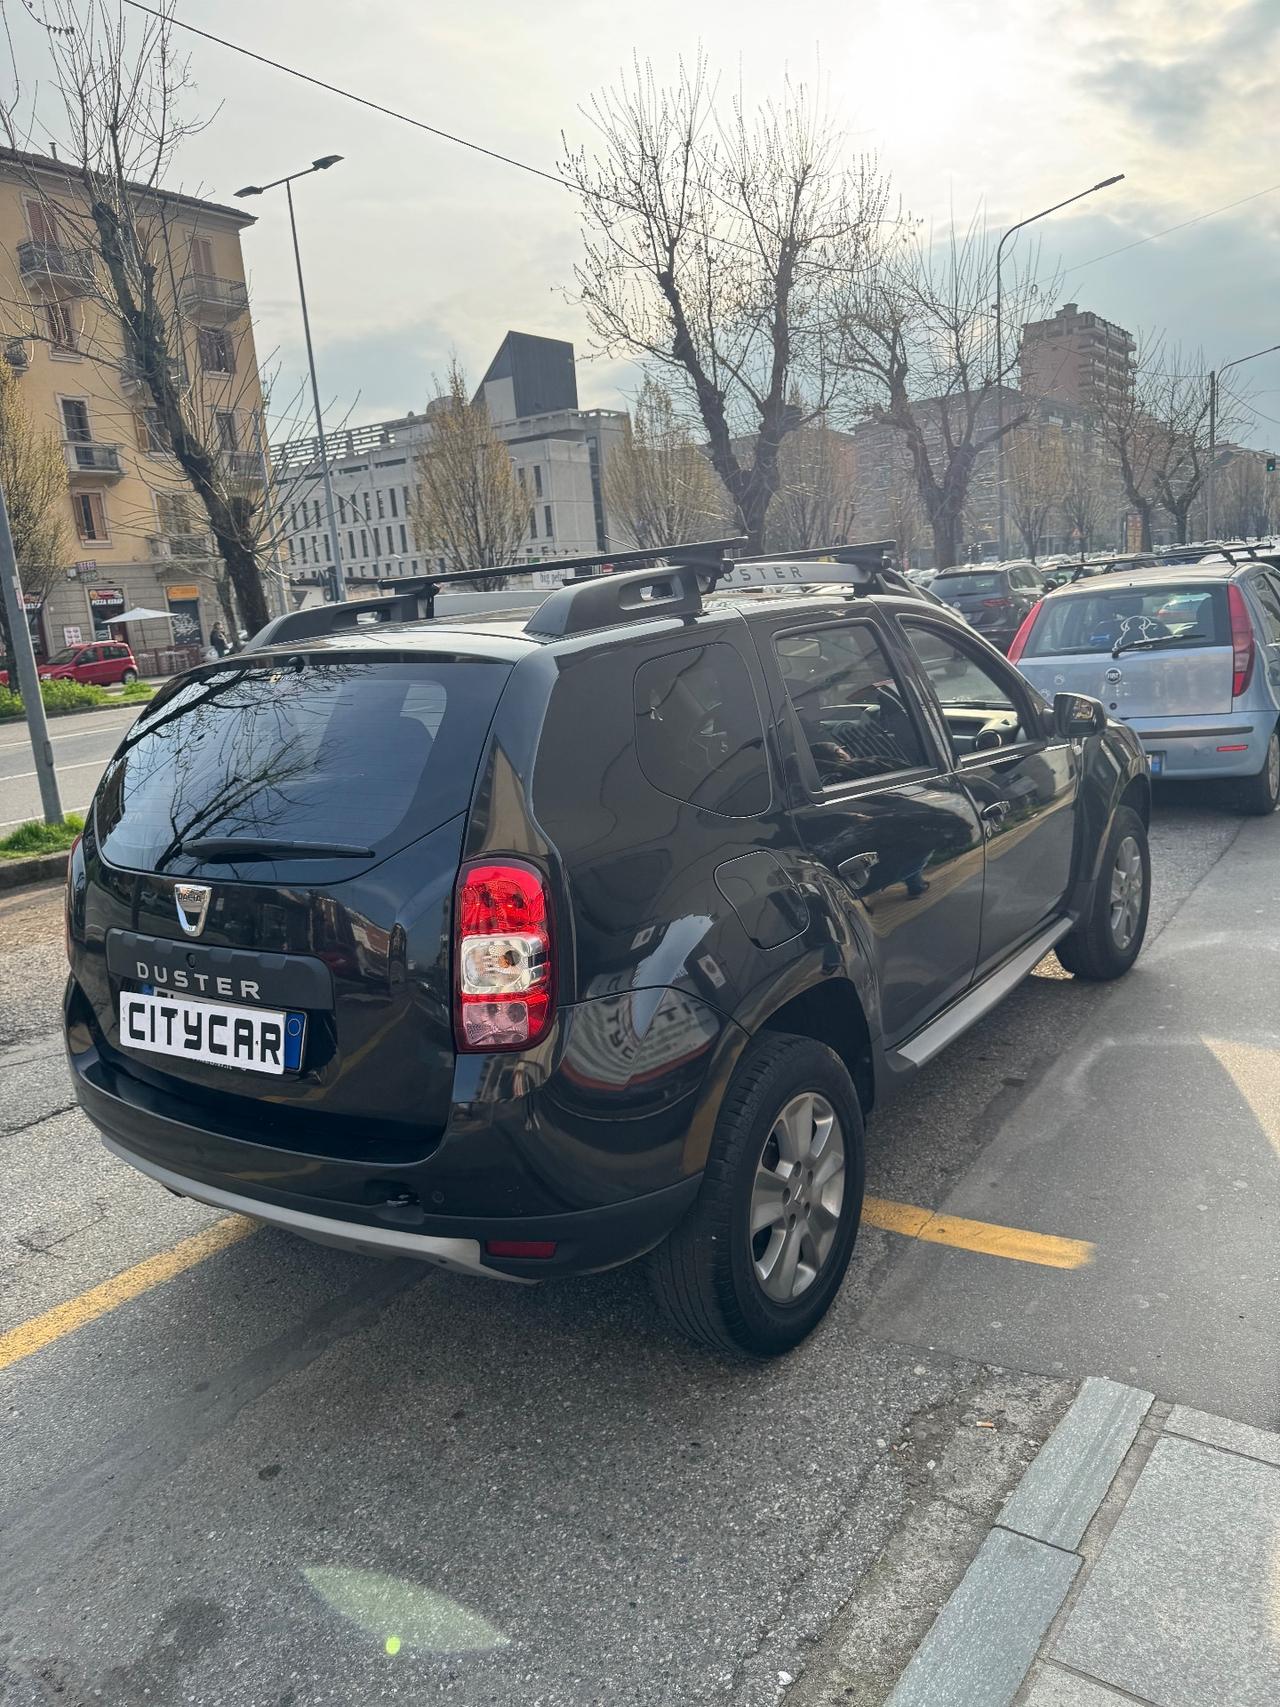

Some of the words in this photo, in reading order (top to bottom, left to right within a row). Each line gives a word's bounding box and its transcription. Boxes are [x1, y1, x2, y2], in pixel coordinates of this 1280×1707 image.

[723, 566, 802, 582] USTER
[136, 961, 261, 1000] DUSTER
[128, 1001, 281, 1066] CITYCAR
